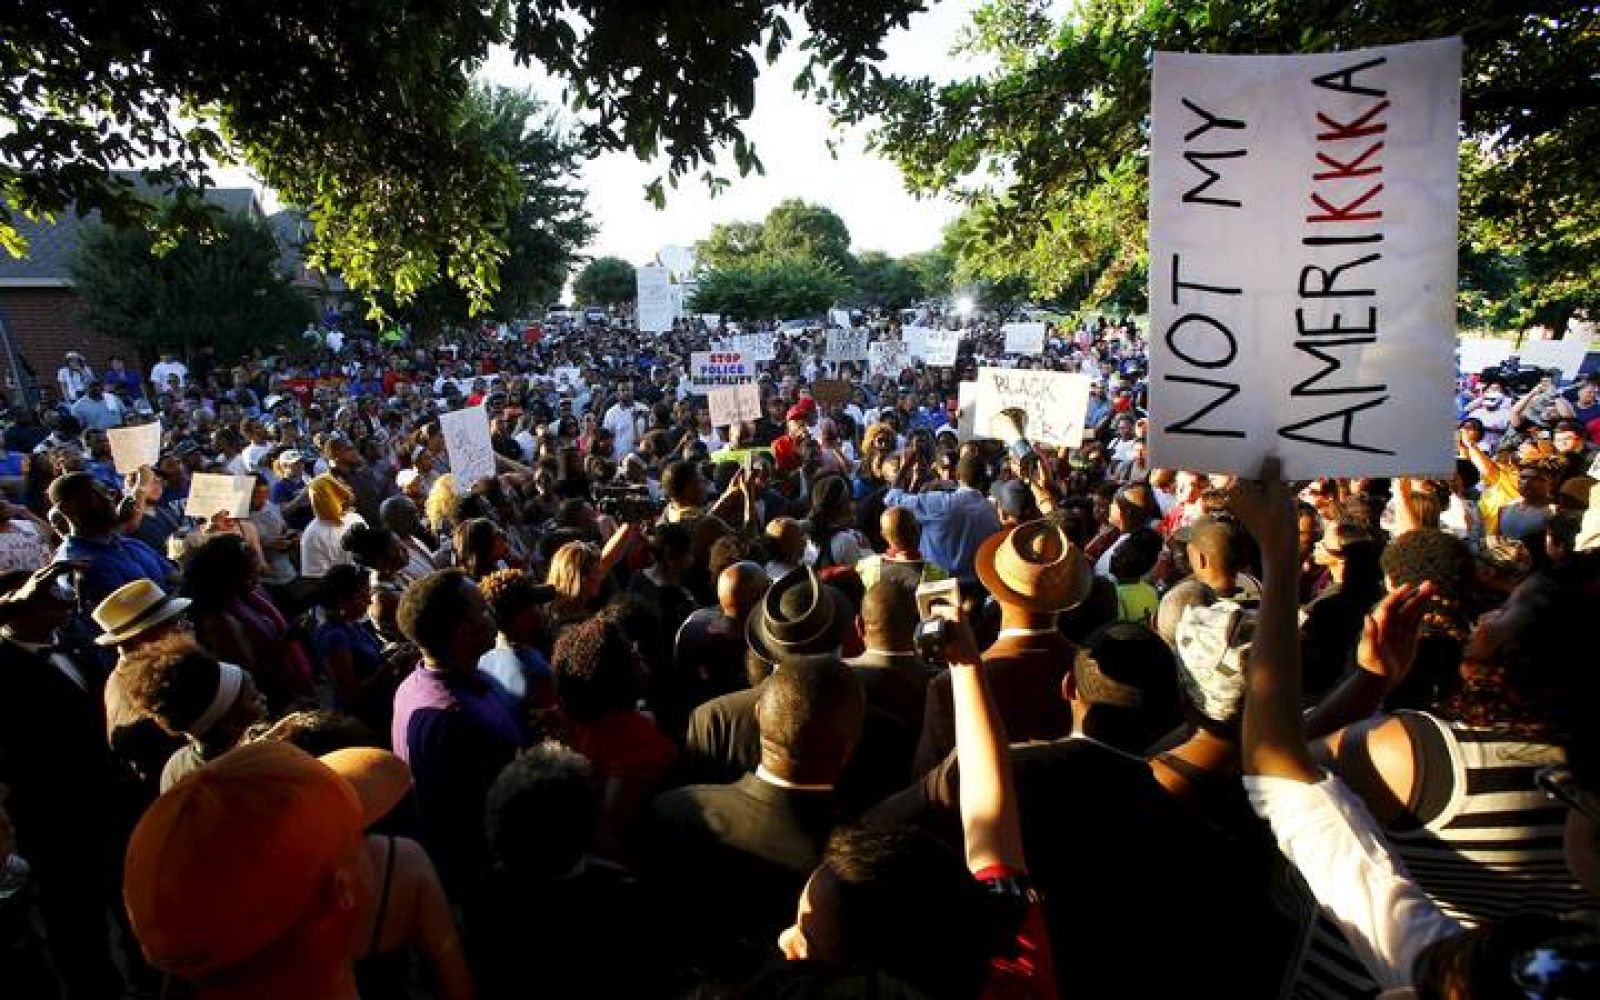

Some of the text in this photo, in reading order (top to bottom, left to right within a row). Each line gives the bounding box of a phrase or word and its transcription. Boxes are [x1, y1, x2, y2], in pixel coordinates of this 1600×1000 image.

[1164, 97, 1247, 438] NOT MY
[1277, 56, 1397, 456] AMERIKKKA
[701, 363, 745, 374] POLICE
[710, 352, 741, 363] STOP
